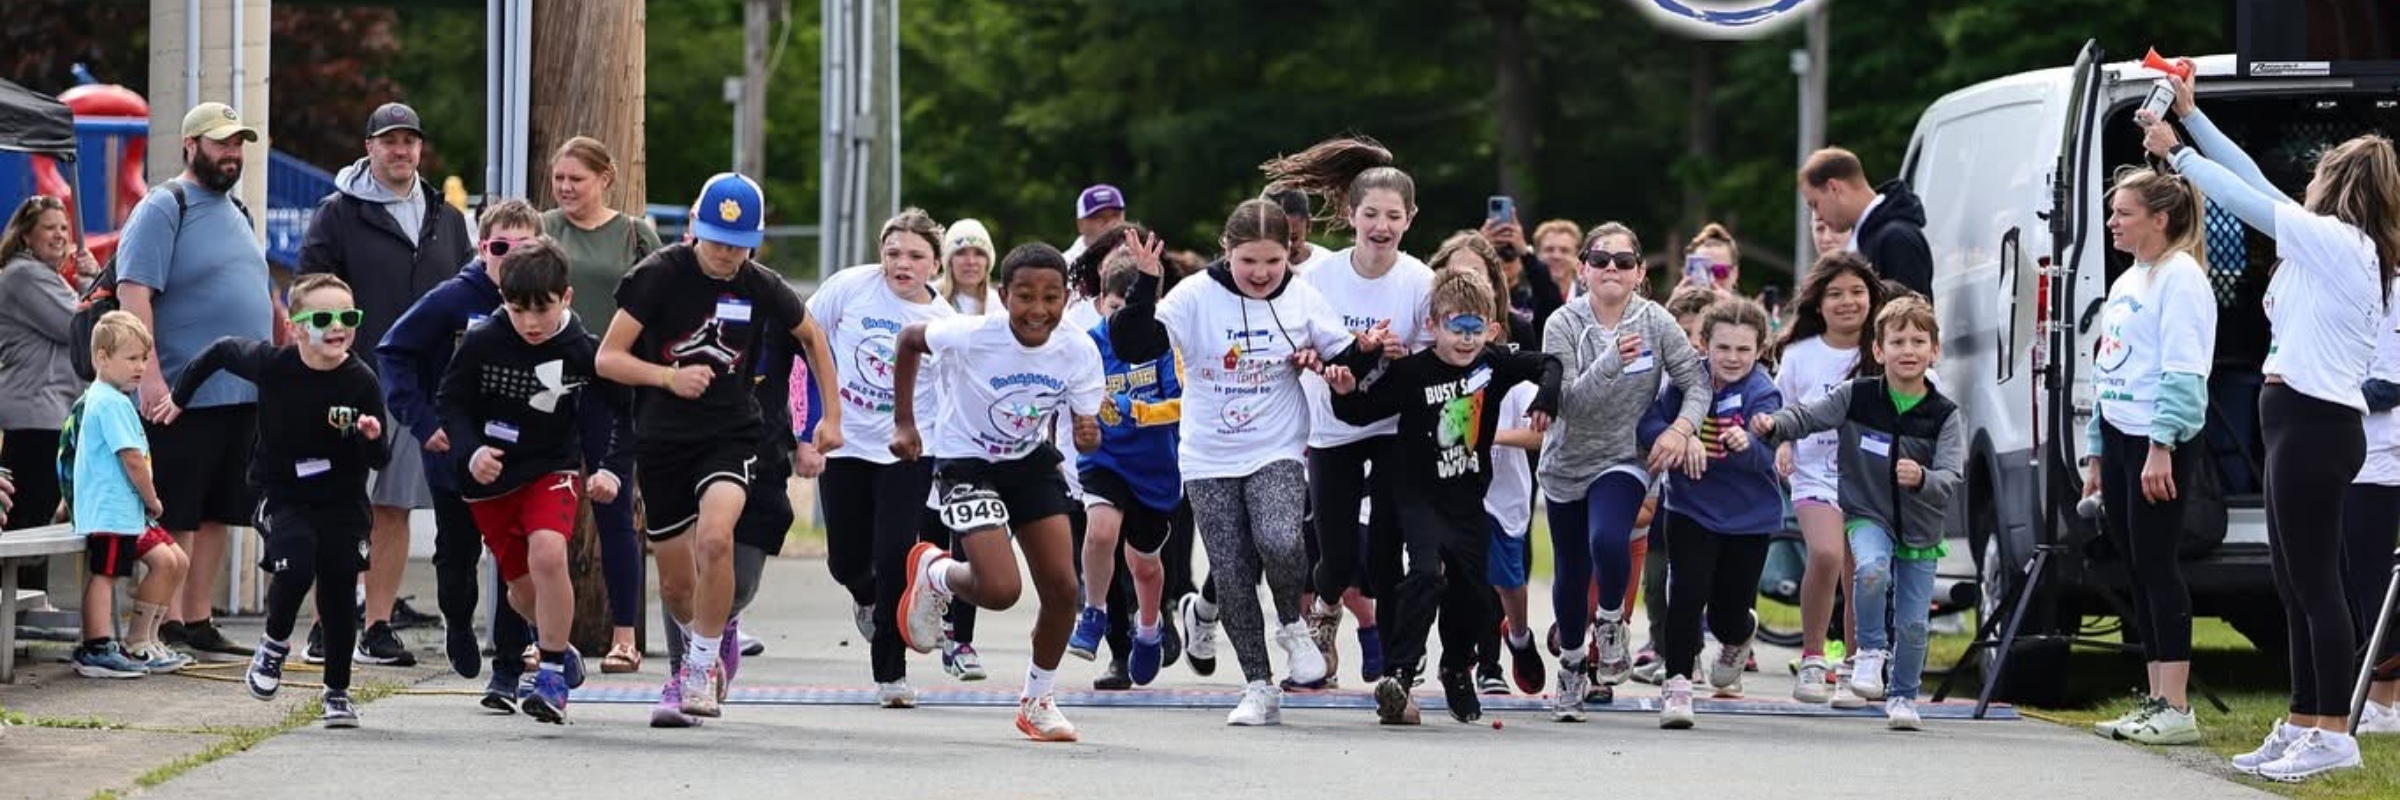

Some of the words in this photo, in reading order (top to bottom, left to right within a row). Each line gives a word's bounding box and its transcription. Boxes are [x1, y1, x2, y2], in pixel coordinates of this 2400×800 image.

[1225, 385, 1258, 395] proud
[1424, 380, 1458, 405] BUSY
[943, 501, 1005, 526] 1949
